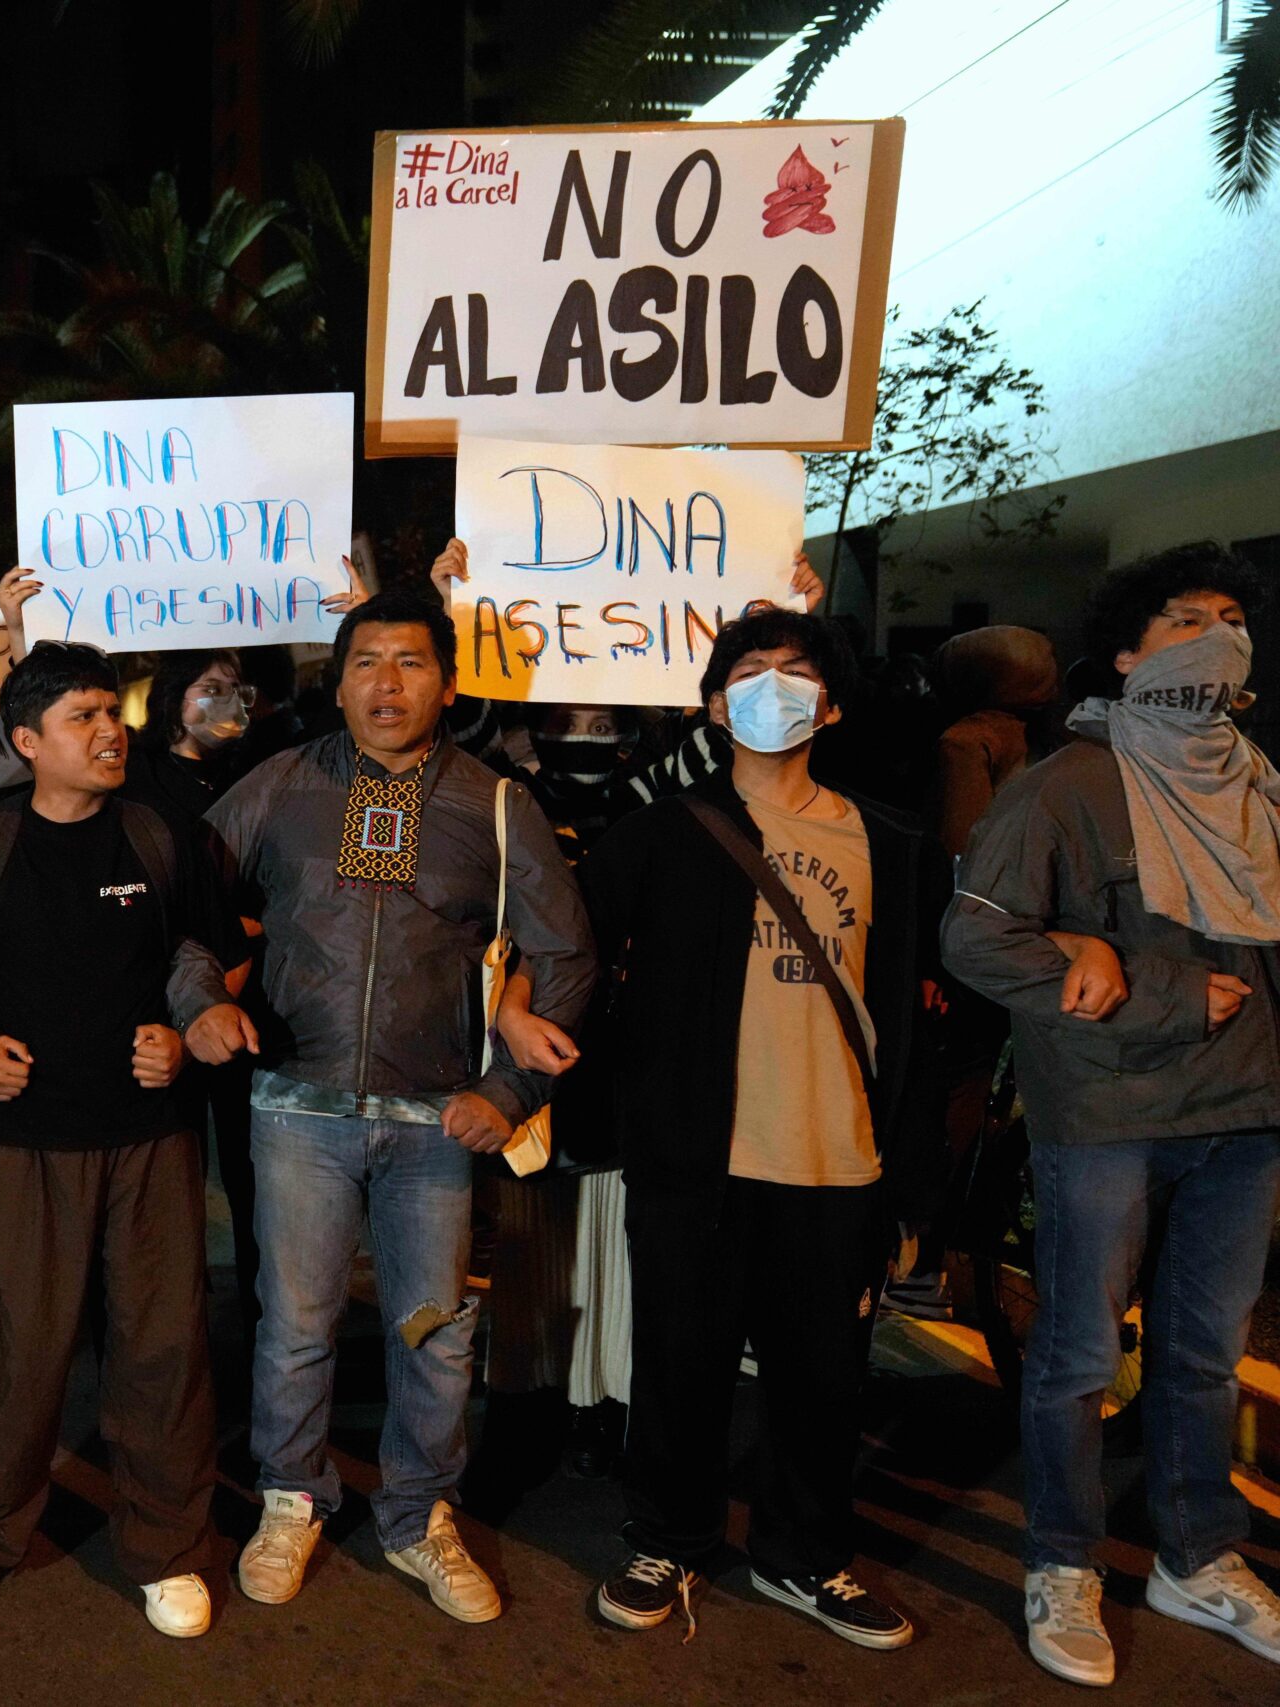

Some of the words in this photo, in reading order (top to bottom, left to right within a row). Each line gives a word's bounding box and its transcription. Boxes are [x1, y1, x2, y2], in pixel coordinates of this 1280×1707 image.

[395, 186, 410, 210] a
[416, 178, 438, 209] la
[445, 170, 520, 205] Carcel
[543, 148, 722, 262] NO
[404, 293, 518, 398] AL
[535, 264, 844, 405] ASILO
[53, 426, 198, 496] DINA
[41, 499, 316, 573] CORRUPTA
[497, 465, 727, 578] DINA
[53, 586, 84, 643] Y
[105, 576, 323, 639] ASESINA
[472, 596, 777, 678] ASESIN
